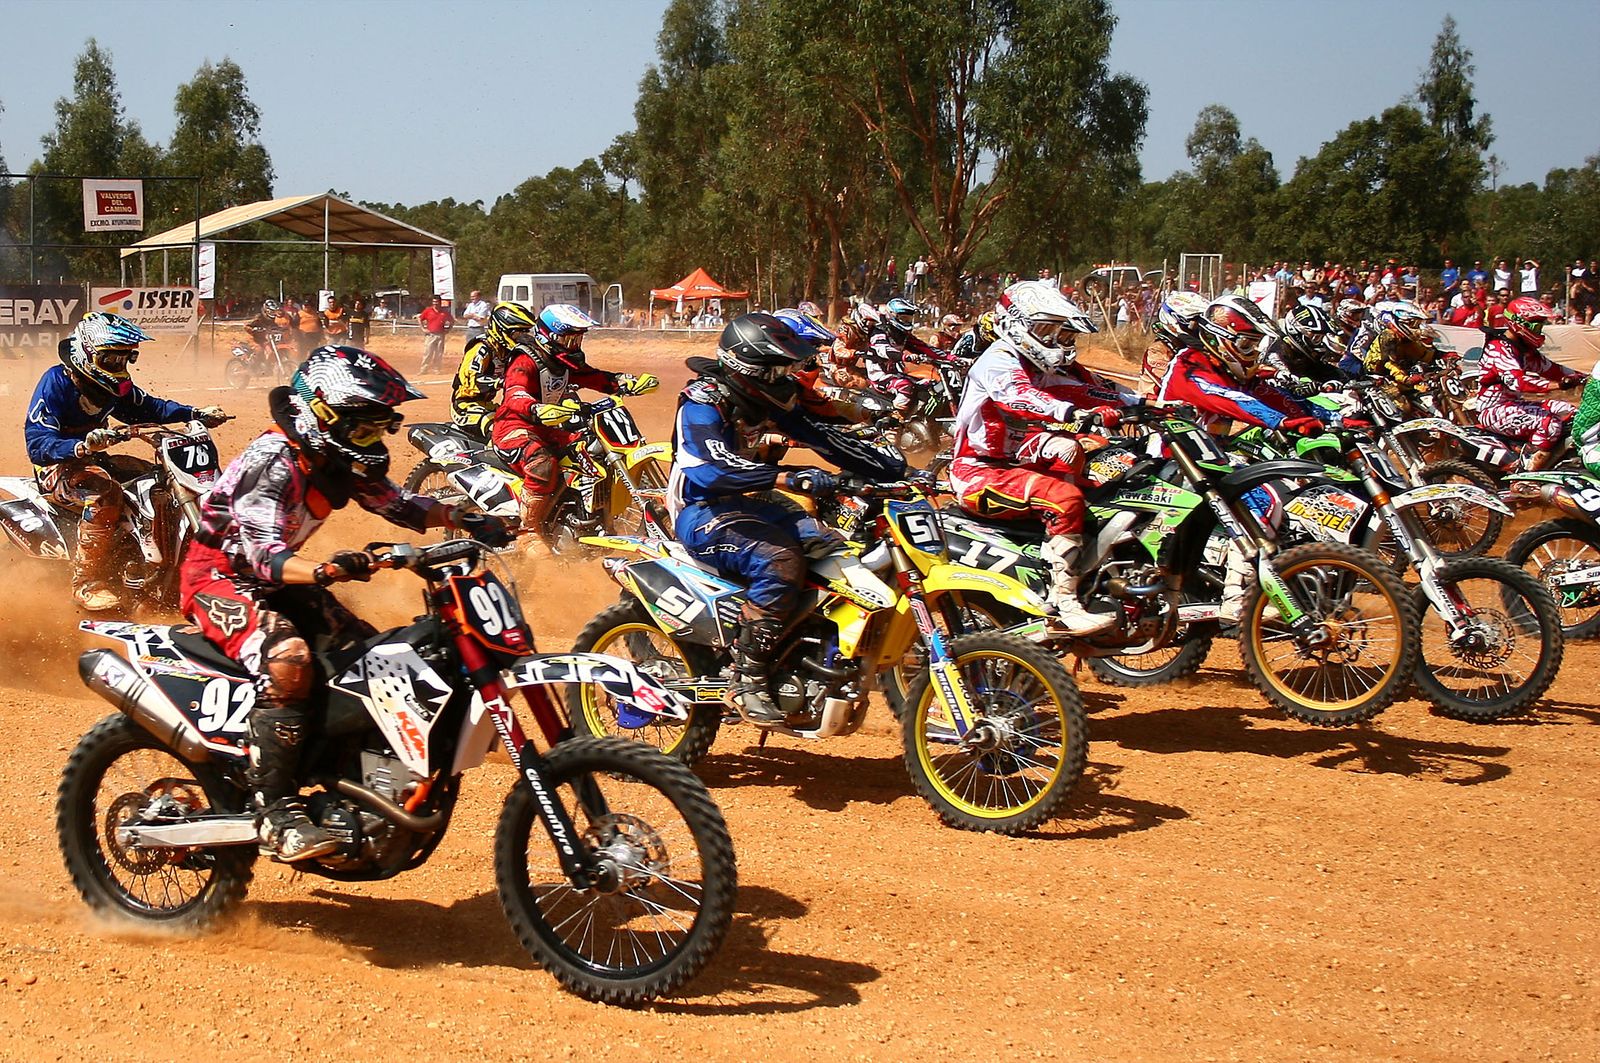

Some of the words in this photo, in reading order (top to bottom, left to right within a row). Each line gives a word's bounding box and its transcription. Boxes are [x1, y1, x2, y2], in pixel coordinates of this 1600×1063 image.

[138, 290, 195, 309] ISSER
[139, 315, 192, 324] publicidad
[602, 407, 639, 446] 12
[183, 443, 210, 469] 78
[11, 508, 44, 533] 78
[905, 514, 941, 544] 51
[958, 539, 1021, 573] 17
[468, 582, 517, 636] 92
[654, 585, 707, 624] 51
[198, 678, 256, 733] 92
[937, 671, 963, 721] MICHELIN
[525, 767, 575, 855] Goldentyre
